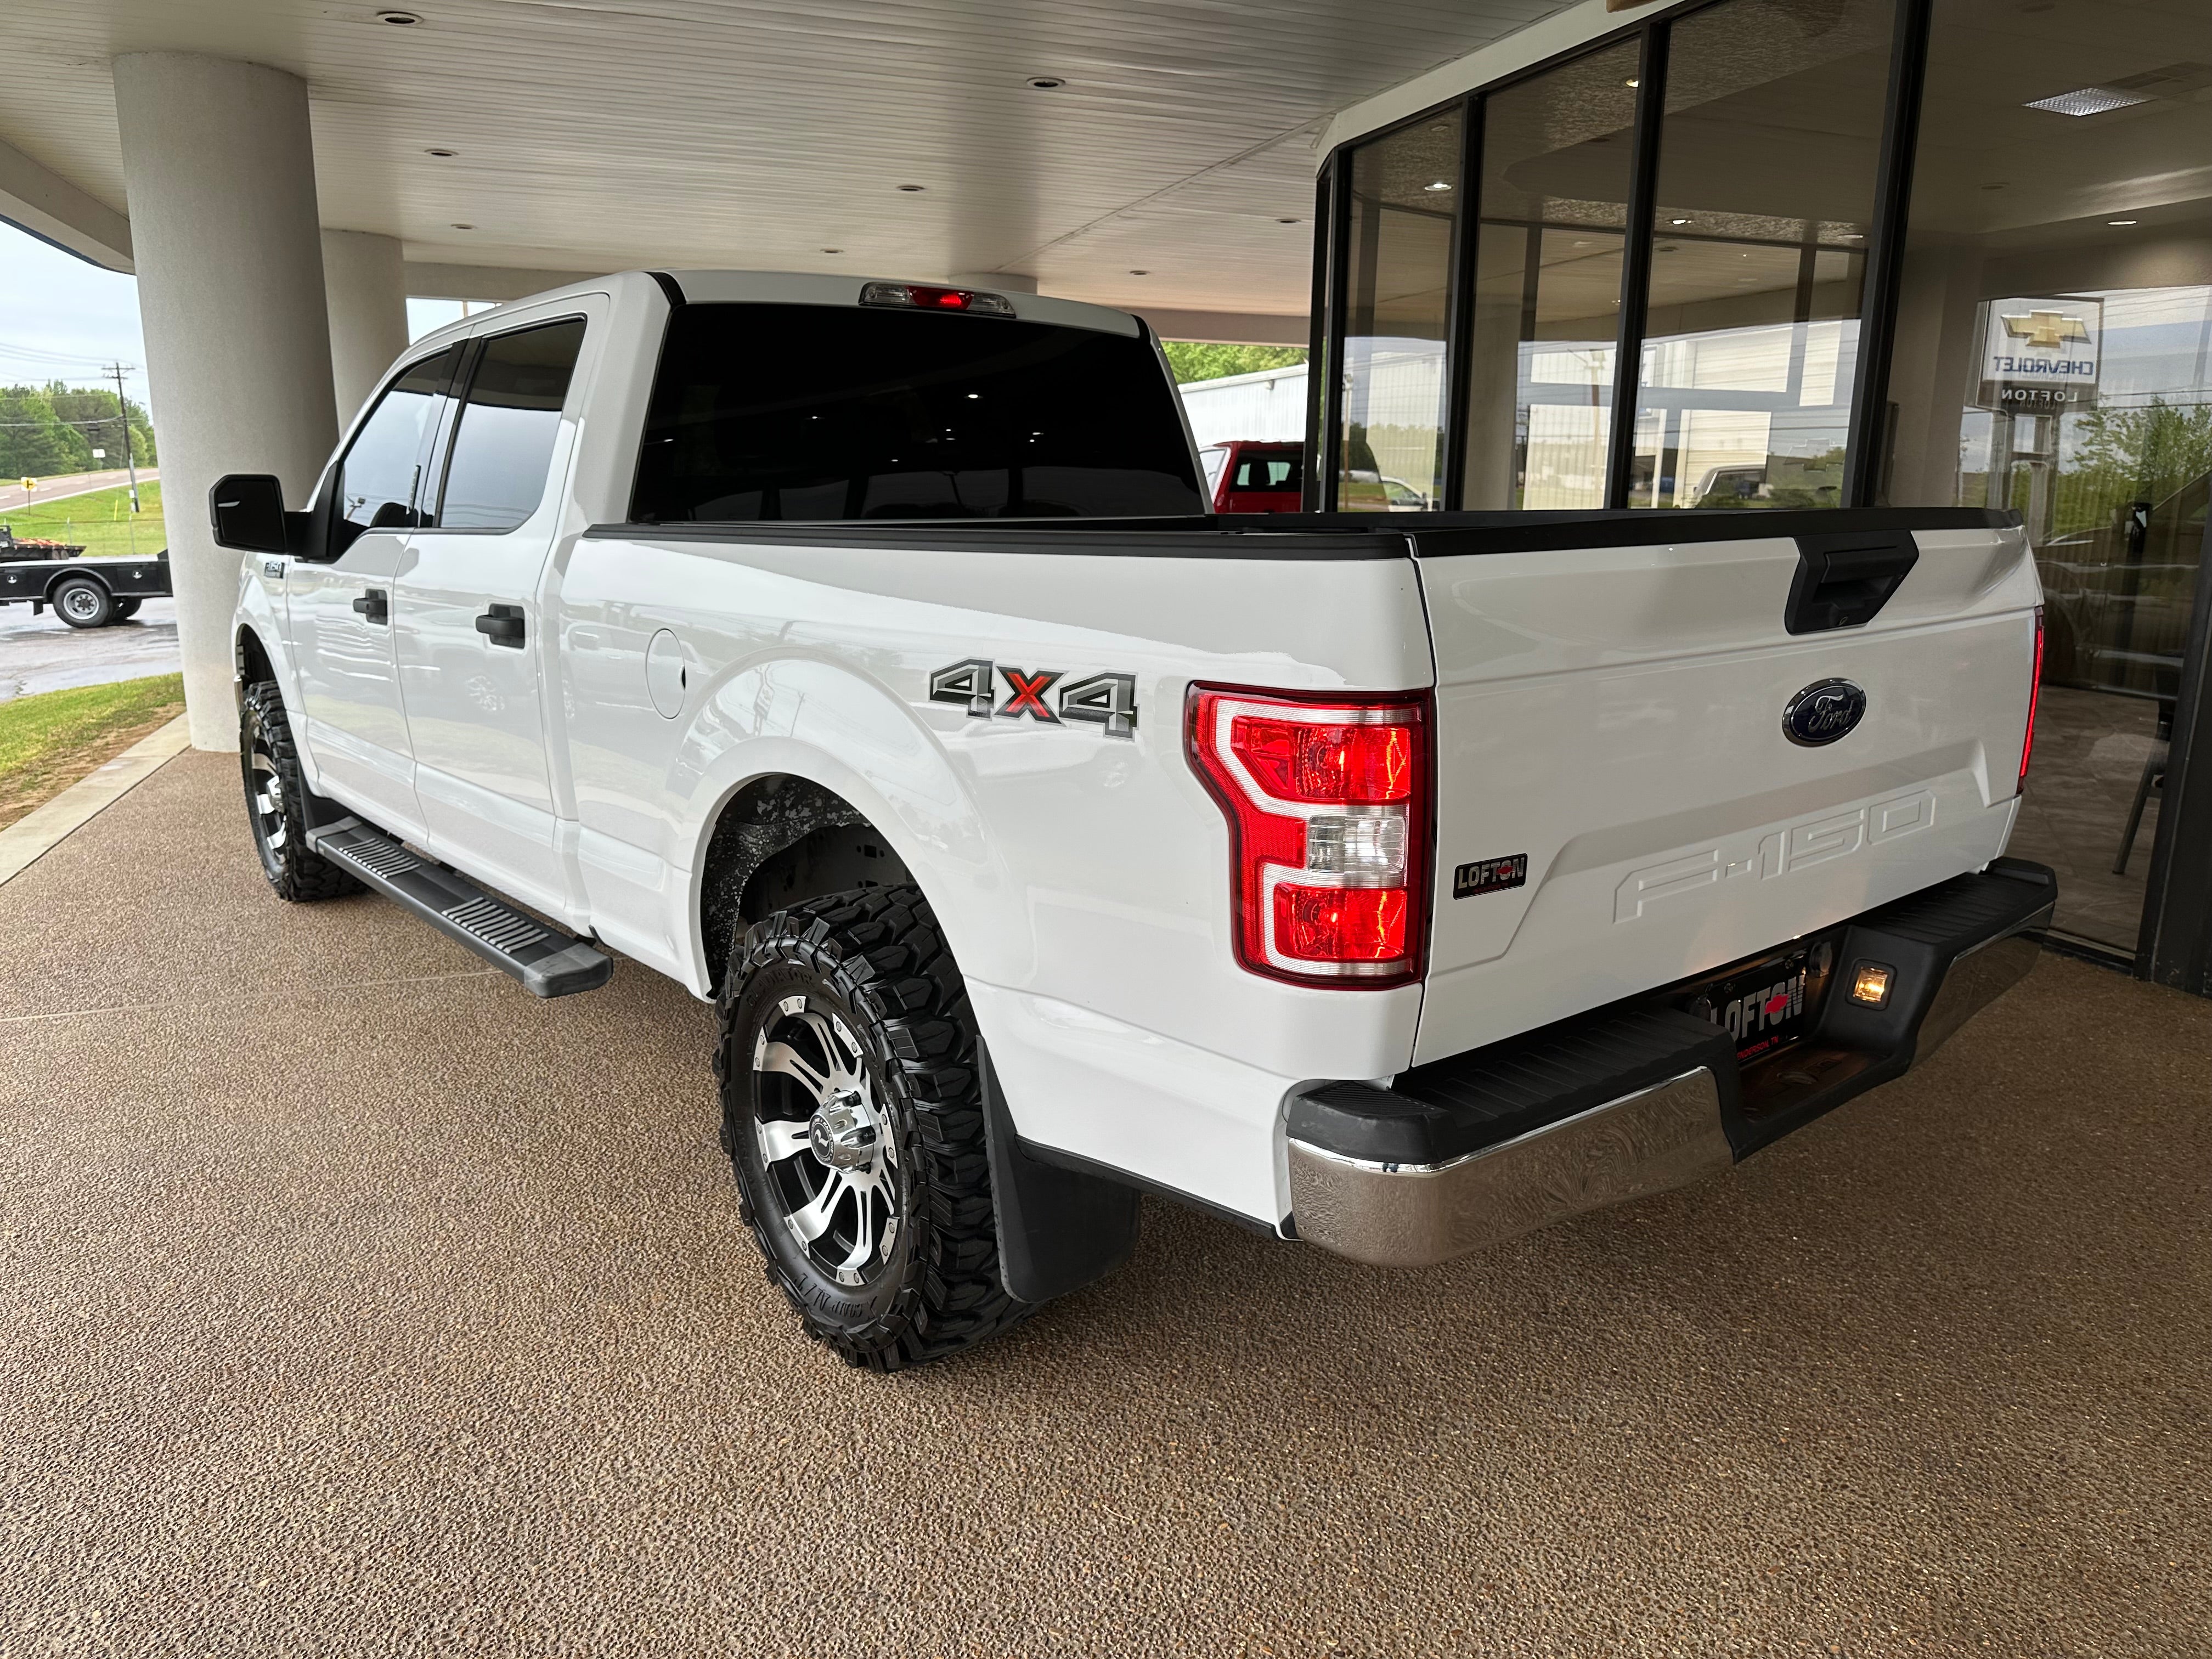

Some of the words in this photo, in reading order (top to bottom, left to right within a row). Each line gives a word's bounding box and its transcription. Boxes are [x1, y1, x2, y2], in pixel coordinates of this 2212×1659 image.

[1808, 694, 1854, 732] Ford
[1458, 857, 1525, 889] LOFTON
[1613, 789, 1936, 924] F-150
[1771, 1035, 1779, 1046] TN
